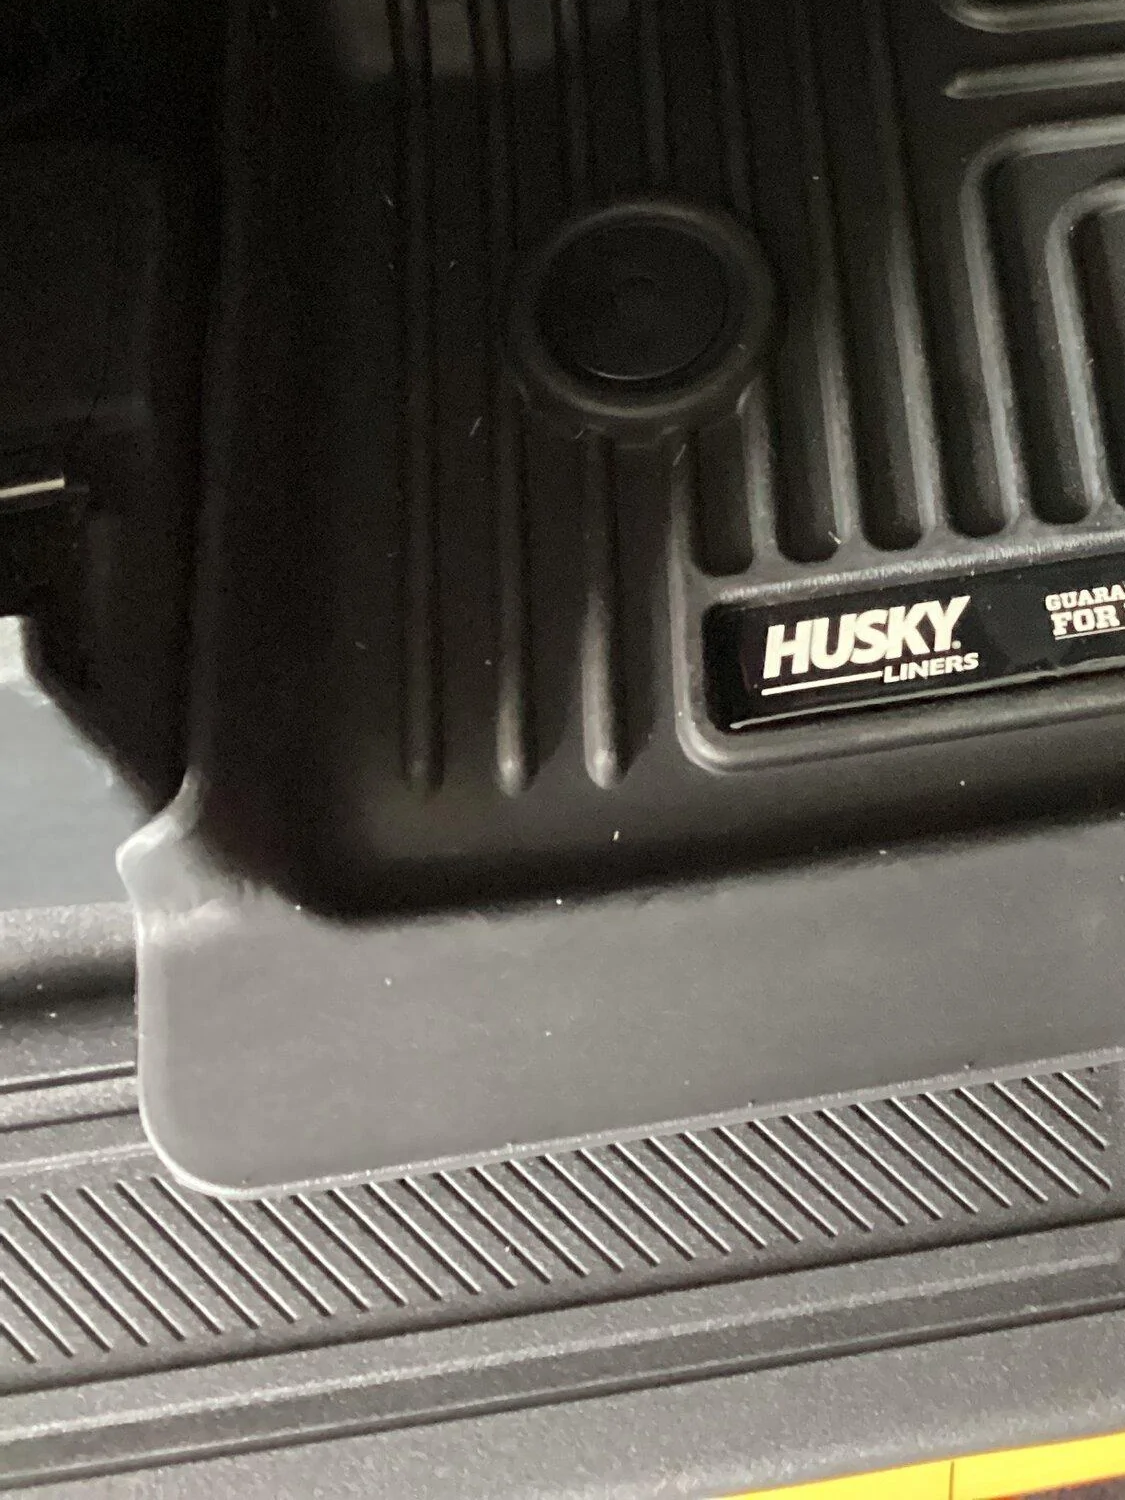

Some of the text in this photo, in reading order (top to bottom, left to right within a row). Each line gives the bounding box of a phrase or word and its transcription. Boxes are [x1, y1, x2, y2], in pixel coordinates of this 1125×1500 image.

[763, 595, 971, 679] HUSKY
[1050, 605, 1120, 637] FOR
[883, 652, 979, 683] LINERS
